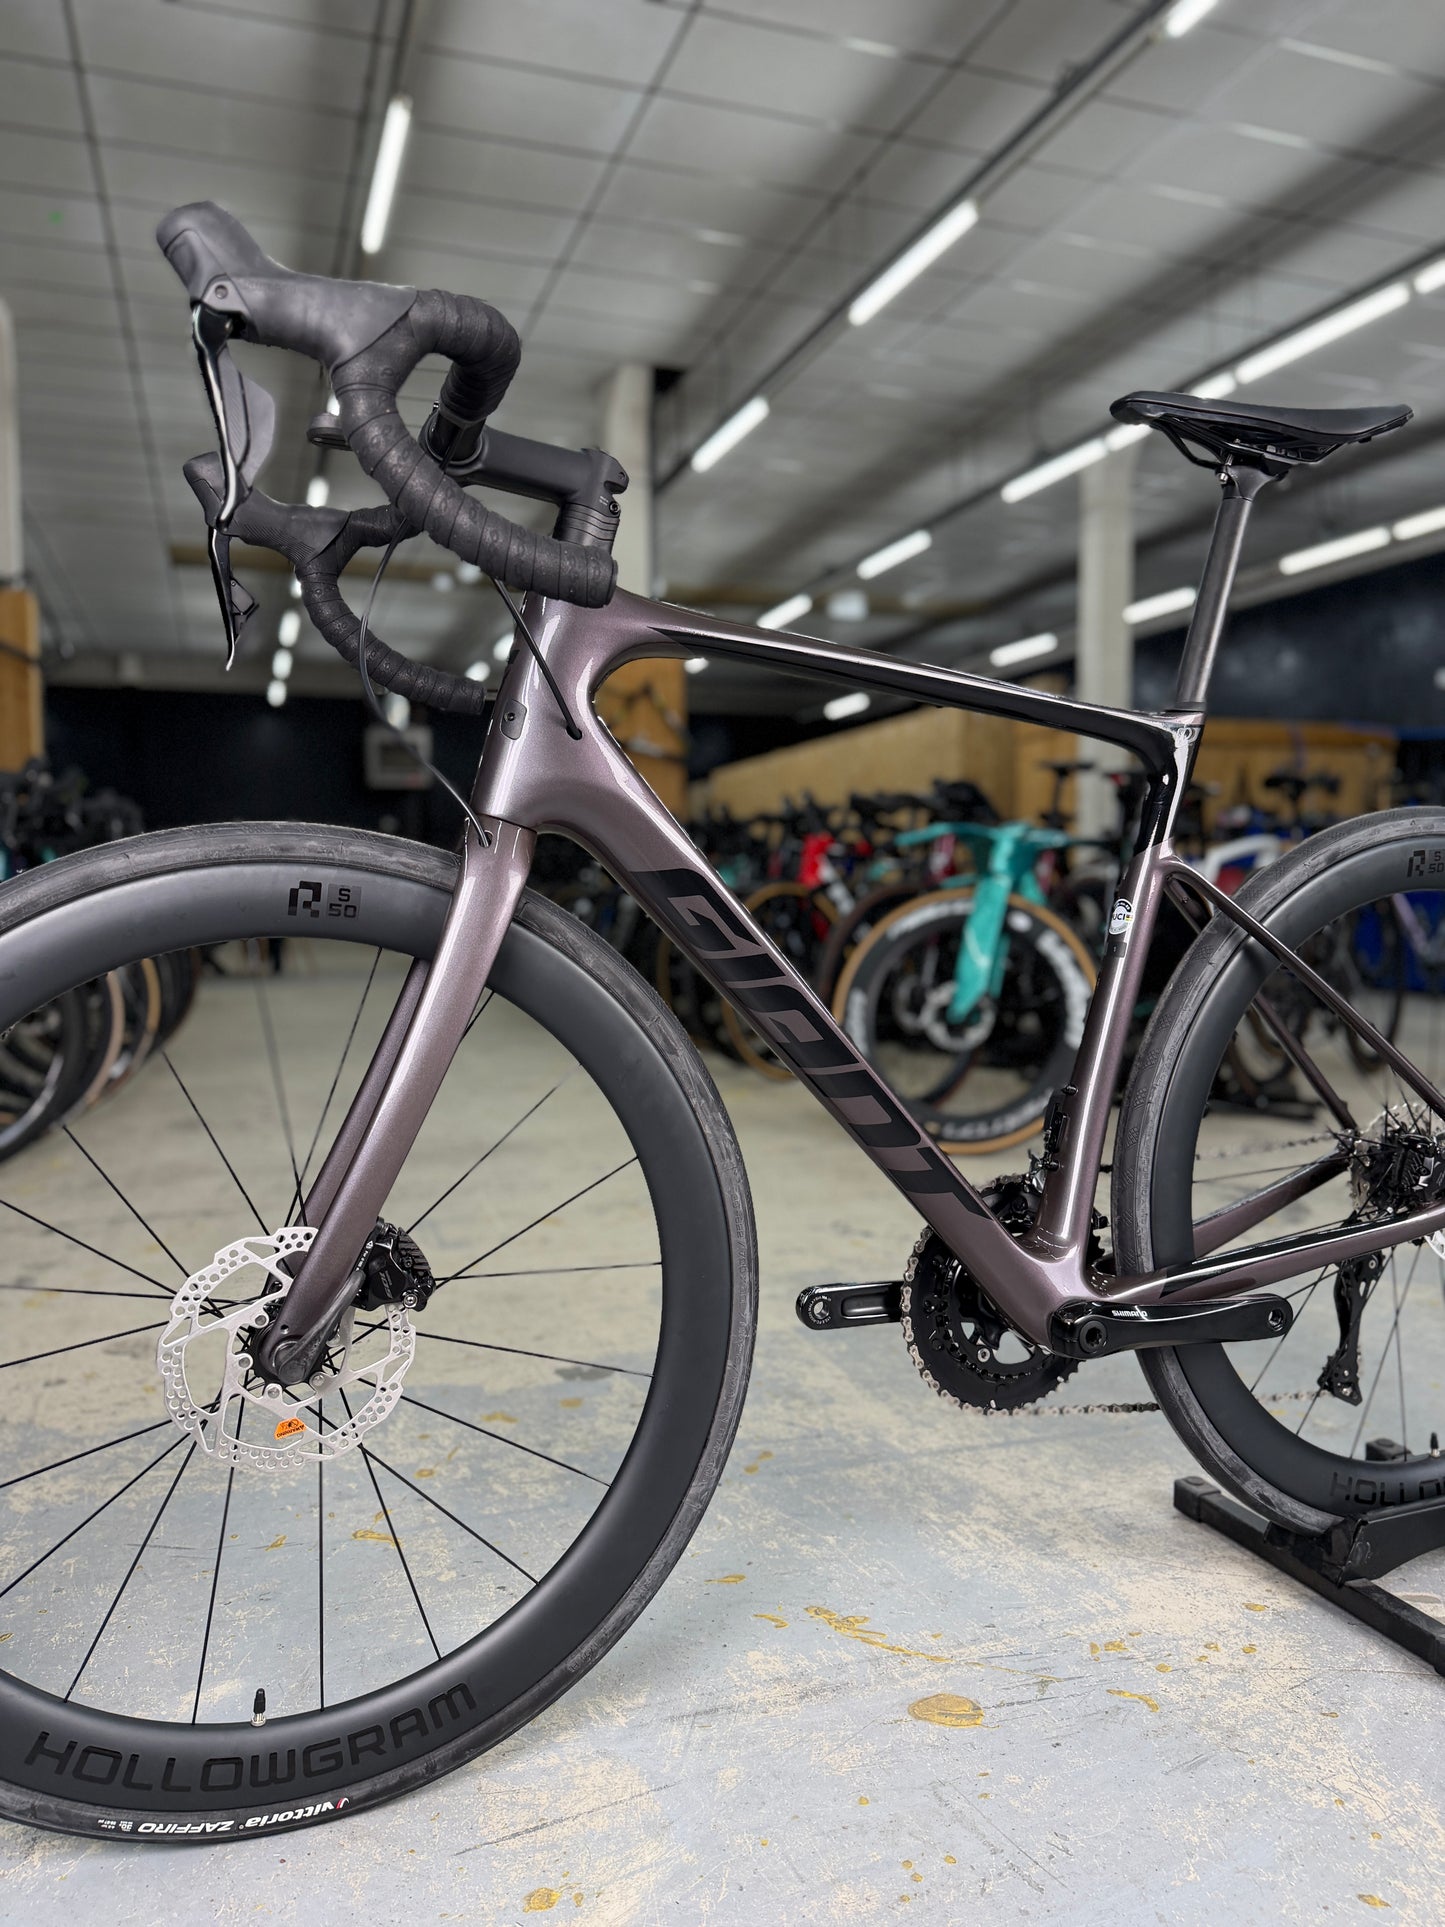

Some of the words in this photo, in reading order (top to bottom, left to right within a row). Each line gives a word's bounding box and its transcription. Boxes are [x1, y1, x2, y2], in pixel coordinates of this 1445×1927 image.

[338, 887, 351, 902] S
[328, 903, 357, 918] 50
[628, 868, 995, 1222] GIANT
[24, 1682, 478, 1793] HOLLOWGRAM
[138, 1820, 235, 1834] ZAFFIRO
